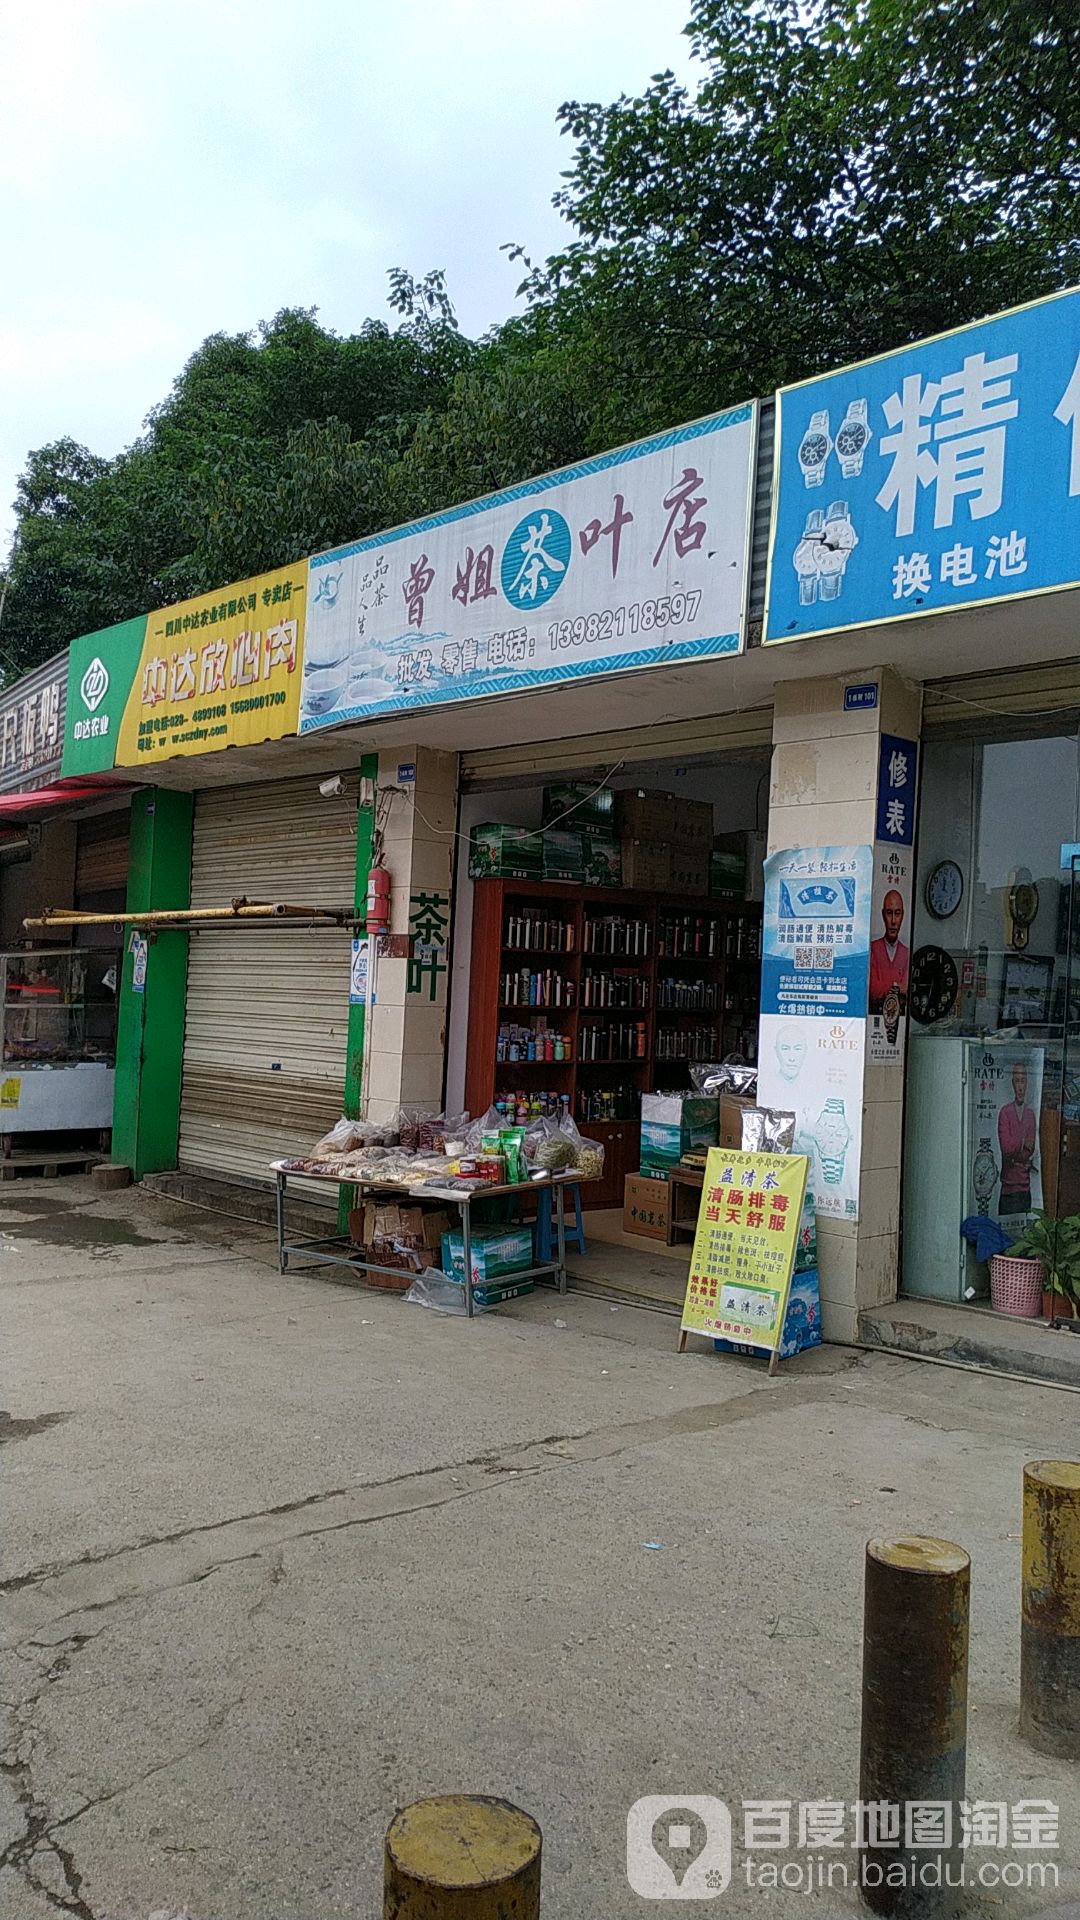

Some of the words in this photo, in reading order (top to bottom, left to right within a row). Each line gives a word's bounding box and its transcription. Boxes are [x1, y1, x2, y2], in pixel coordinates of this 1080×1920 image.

[875, 340, 1080, 538] 精
[402, 467, 708, 629] 曾姐茶叶店
[891, 530, 1028, 600] 换电池
[261, 581, 293, 607] 专卖店
[397, 647, 432, 684] 批发
[442, 638, 478, 675] 零售
[548, 589, 703, 651] 13982118597
[141, 618, 298, 707] 中达放心肉
[74, 714, 109, 741] 中达农业
[886, 751, 908, 836] 修表
[881, 864, 907, 876] RATE
[407, 892, 450, 1001] 茶叶
[818, 1039, 859, 1050] RATE
[974, 1068, 1005, 1080] RATE
[717, 1167, 780, 1190] 益清茶
[707, 1186, 790, 1213] 清肠排毒
[705, 1205, 787, 1232] 当天舒服
[690, 1285, 717, 1297] 价格低
[691, 1275, 718, 1287] 效果好
[725, 1298, 768, 1316] 益清茶
